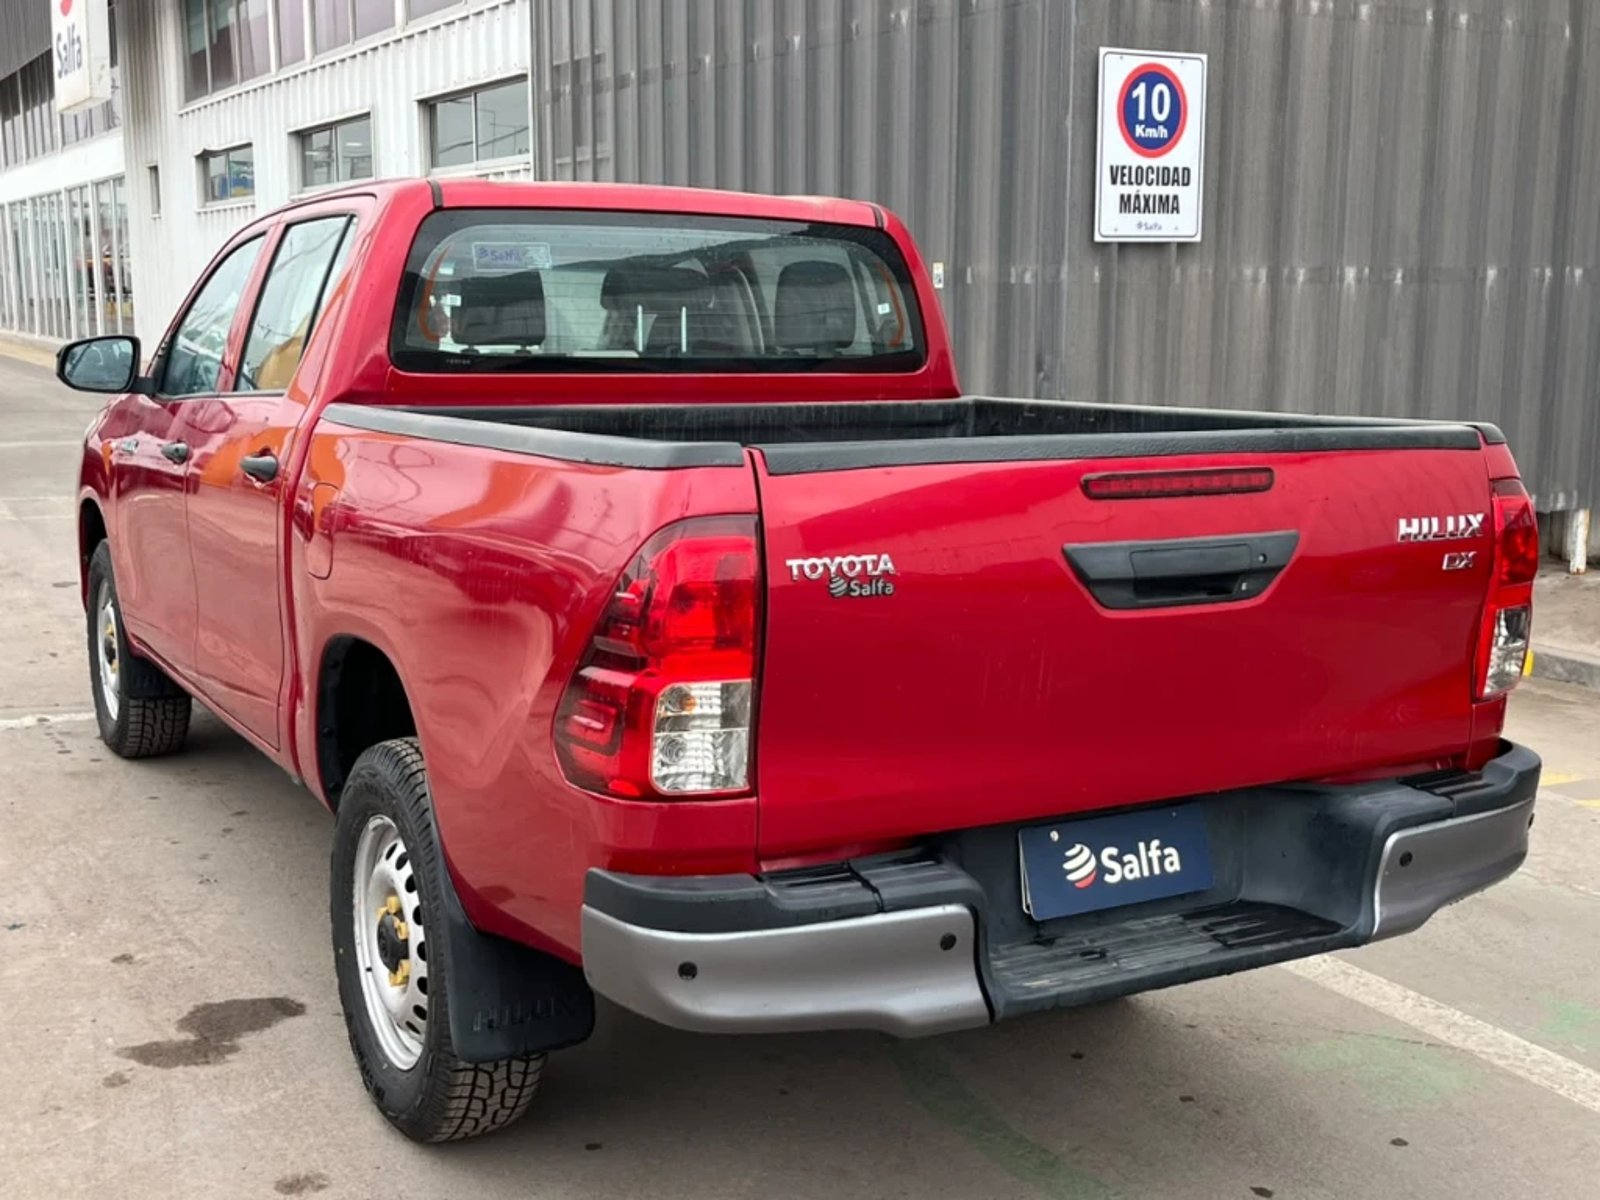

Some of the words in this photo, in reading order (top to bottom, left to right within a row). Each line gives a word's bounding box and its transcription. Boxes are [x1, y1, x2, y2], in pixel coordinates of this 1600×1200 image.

[56, 23, 82, 79] Salfa
[1131, 82, 1171, 122] 10
[1135, 124, 1168, 138] Km/h
[1110, 165, 1191, 186] VELOCIDAD
[1119, 189, 1180, 214] MÁXIMA
[1398, 513, 1484, 542] HILUX
[786, 553, 896, 580] TOYOTA
[1442, 551, 1477, 570] DX
[849, 578, 894, 596] Salfa
[1100, 839, 1181, 884] Salfa
